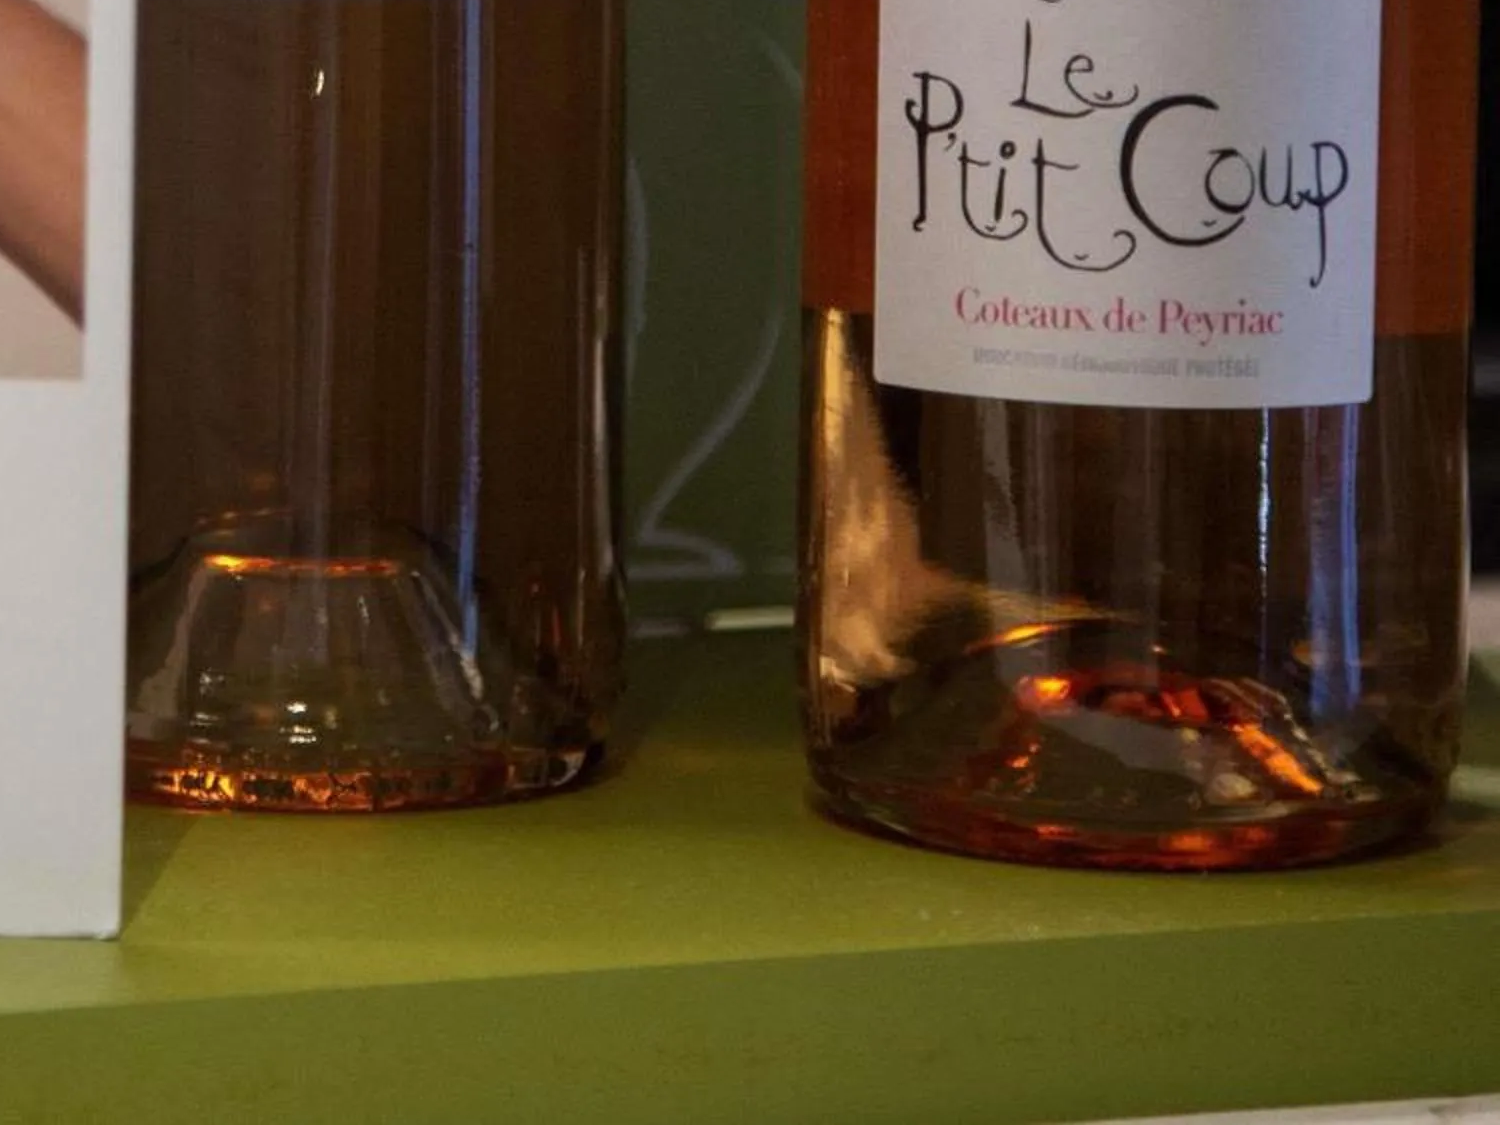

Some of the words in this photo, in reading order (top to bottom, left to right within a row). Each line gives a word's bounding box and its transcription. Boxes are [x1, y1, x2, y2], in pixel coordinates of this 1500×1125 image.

[1011, 18, 1140, 119] Le
[1119, 93, 1349, 288] Coup
[955, 287, 1095, 333] Coteaux
[1102, 297, 1148, 335] de
[1158, 298, 1285, 347] Peyriac
